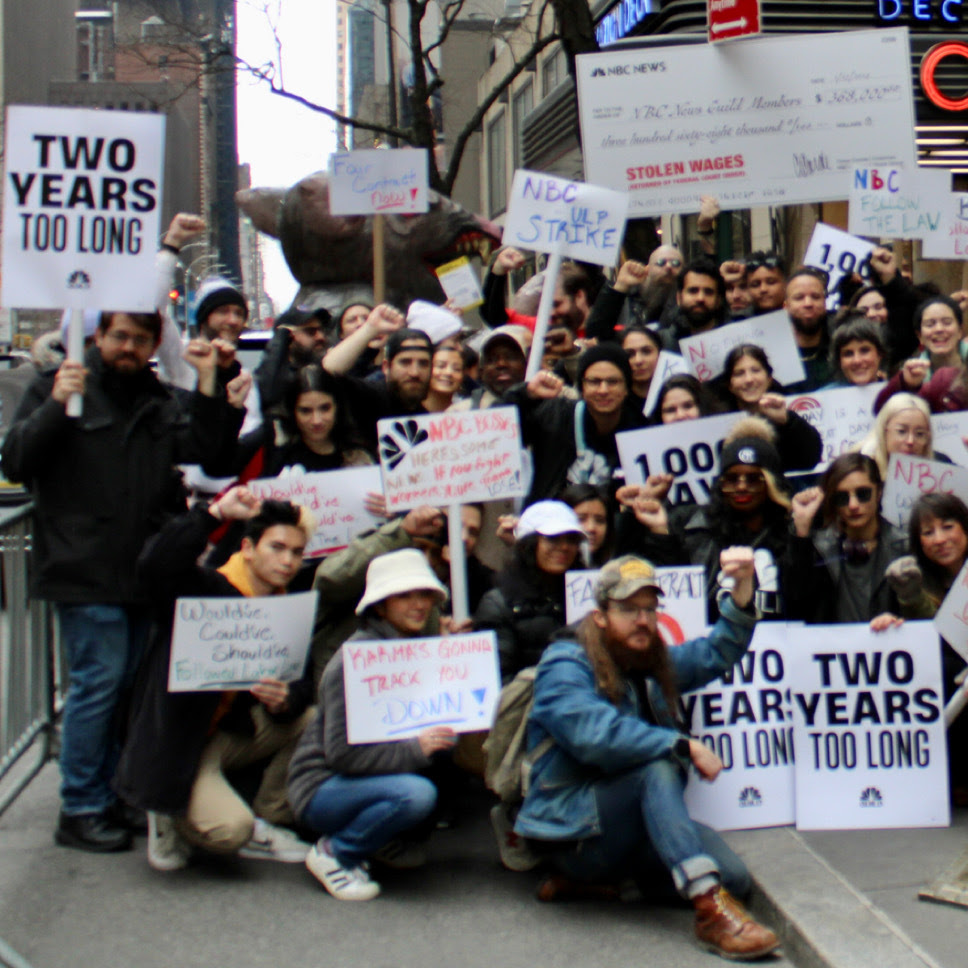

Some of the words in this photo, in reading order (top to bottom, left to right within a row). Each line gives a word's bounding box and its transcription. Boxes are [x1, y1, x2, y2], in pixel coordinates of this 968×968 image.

[607, 65, 630, 75] NBC
[633, 62, 666, 72] NEWS
[33, 134, 136, 173] TWO
[626, 161, 684, 181] STOLEN
[690, 154, 744, 173] WAGES
[9, 171, 157, 213] YEARS
[523, 177, 577, 203] NBC
[854, 168, 899, 192] NBC
[516, 214, 616, 249] STRIKE
[571, 206, 608, 225] ULP
[862, 213, 896, 233] THE
[902, 211, 941, 232] LAW
[20, 213, 67, 252] TOO
[78, 214, 142, 255] LONG
[894, 460, 954, 494] NBC
[348, 642, 431, 670] KARMA'S
[438, 638, 493, 659] GONNA
[722, 649, 784, 685] WO
[813, 650, 914, 687] TWO
[361, 670, 420, 697] TRACK
[438, 665, 469, 684] YOU
[793, 688, 940, 726] YEARS
[810, 731, 857, 770] TOO
[867, 729, 930, 769] LONG
